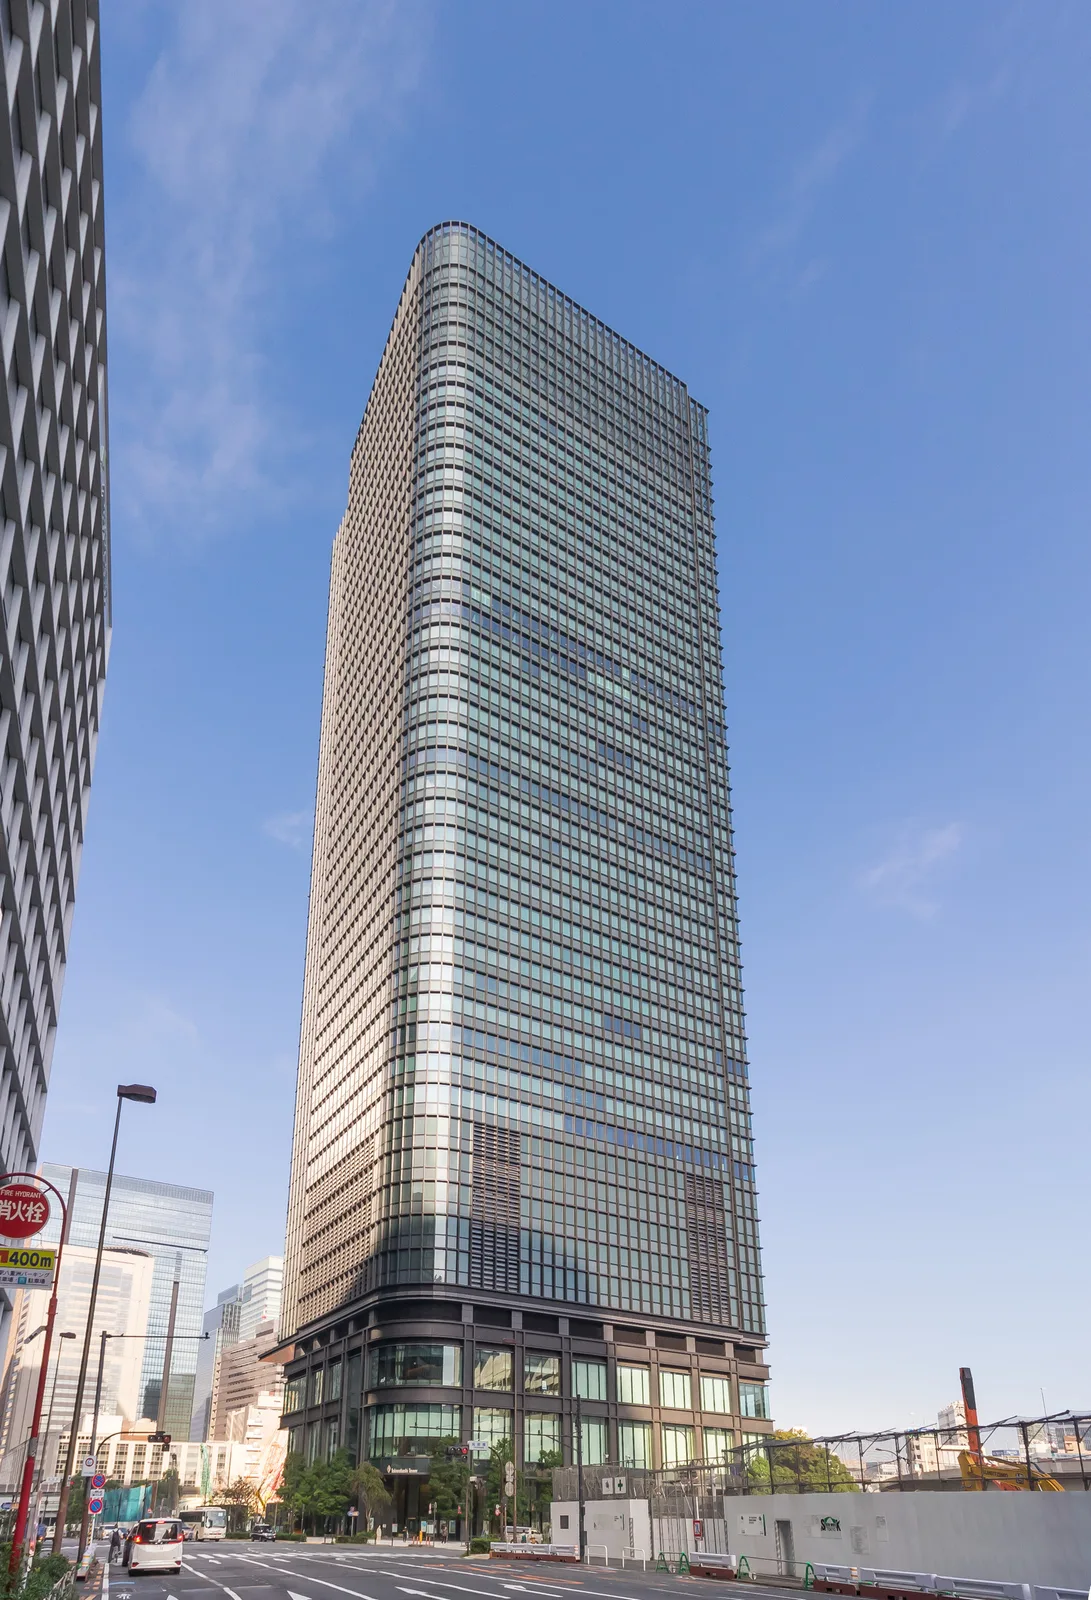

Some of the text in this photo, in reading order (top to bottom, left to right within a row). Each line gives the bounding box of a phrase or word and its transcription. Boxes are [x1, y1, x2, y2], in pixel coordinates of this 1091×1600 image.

[15, 1190, 41, 1199] HYDRANT
[0, 1199, 46, 1223] 消火栓
[9, 1251, 52, 1268] 400m
